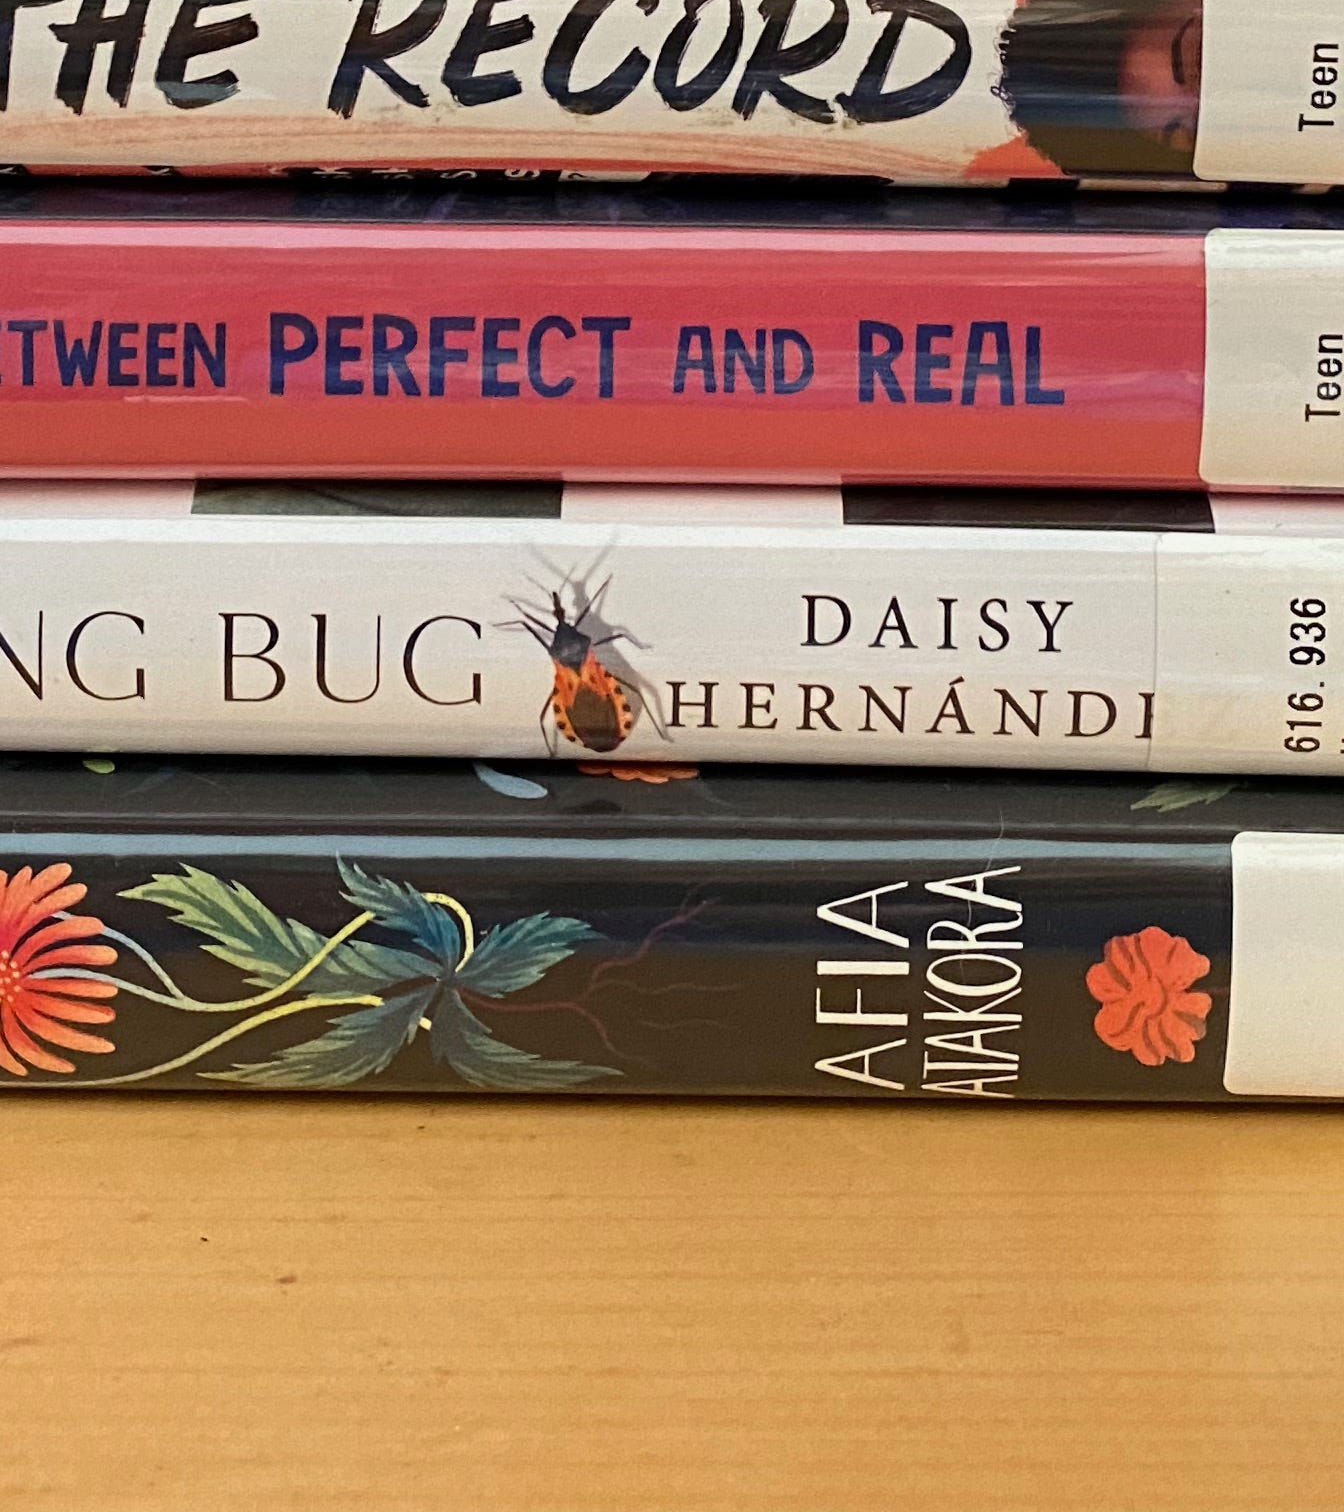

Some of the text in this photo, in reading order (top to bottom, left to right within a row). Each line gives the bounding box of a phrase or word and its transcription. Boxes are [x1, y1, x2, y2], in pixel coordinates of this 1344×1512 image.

[1297, 43, 1340, 132] Teen
[269, 313, 631, 399] PERFECT
[672, 323, 815, 395] AND
[858, 319, 1064, 409] REAL
[1304, 333, 1343, 423] Teen
[217, 612, 484, 707] BUG
[800, 593, 1076, 655] DAISY
[666, 675, 1153, 740] HERNÁND
[813, 879, 913, 1094] AFIA
[920, 864, 1023, 1099] ATAKORA
